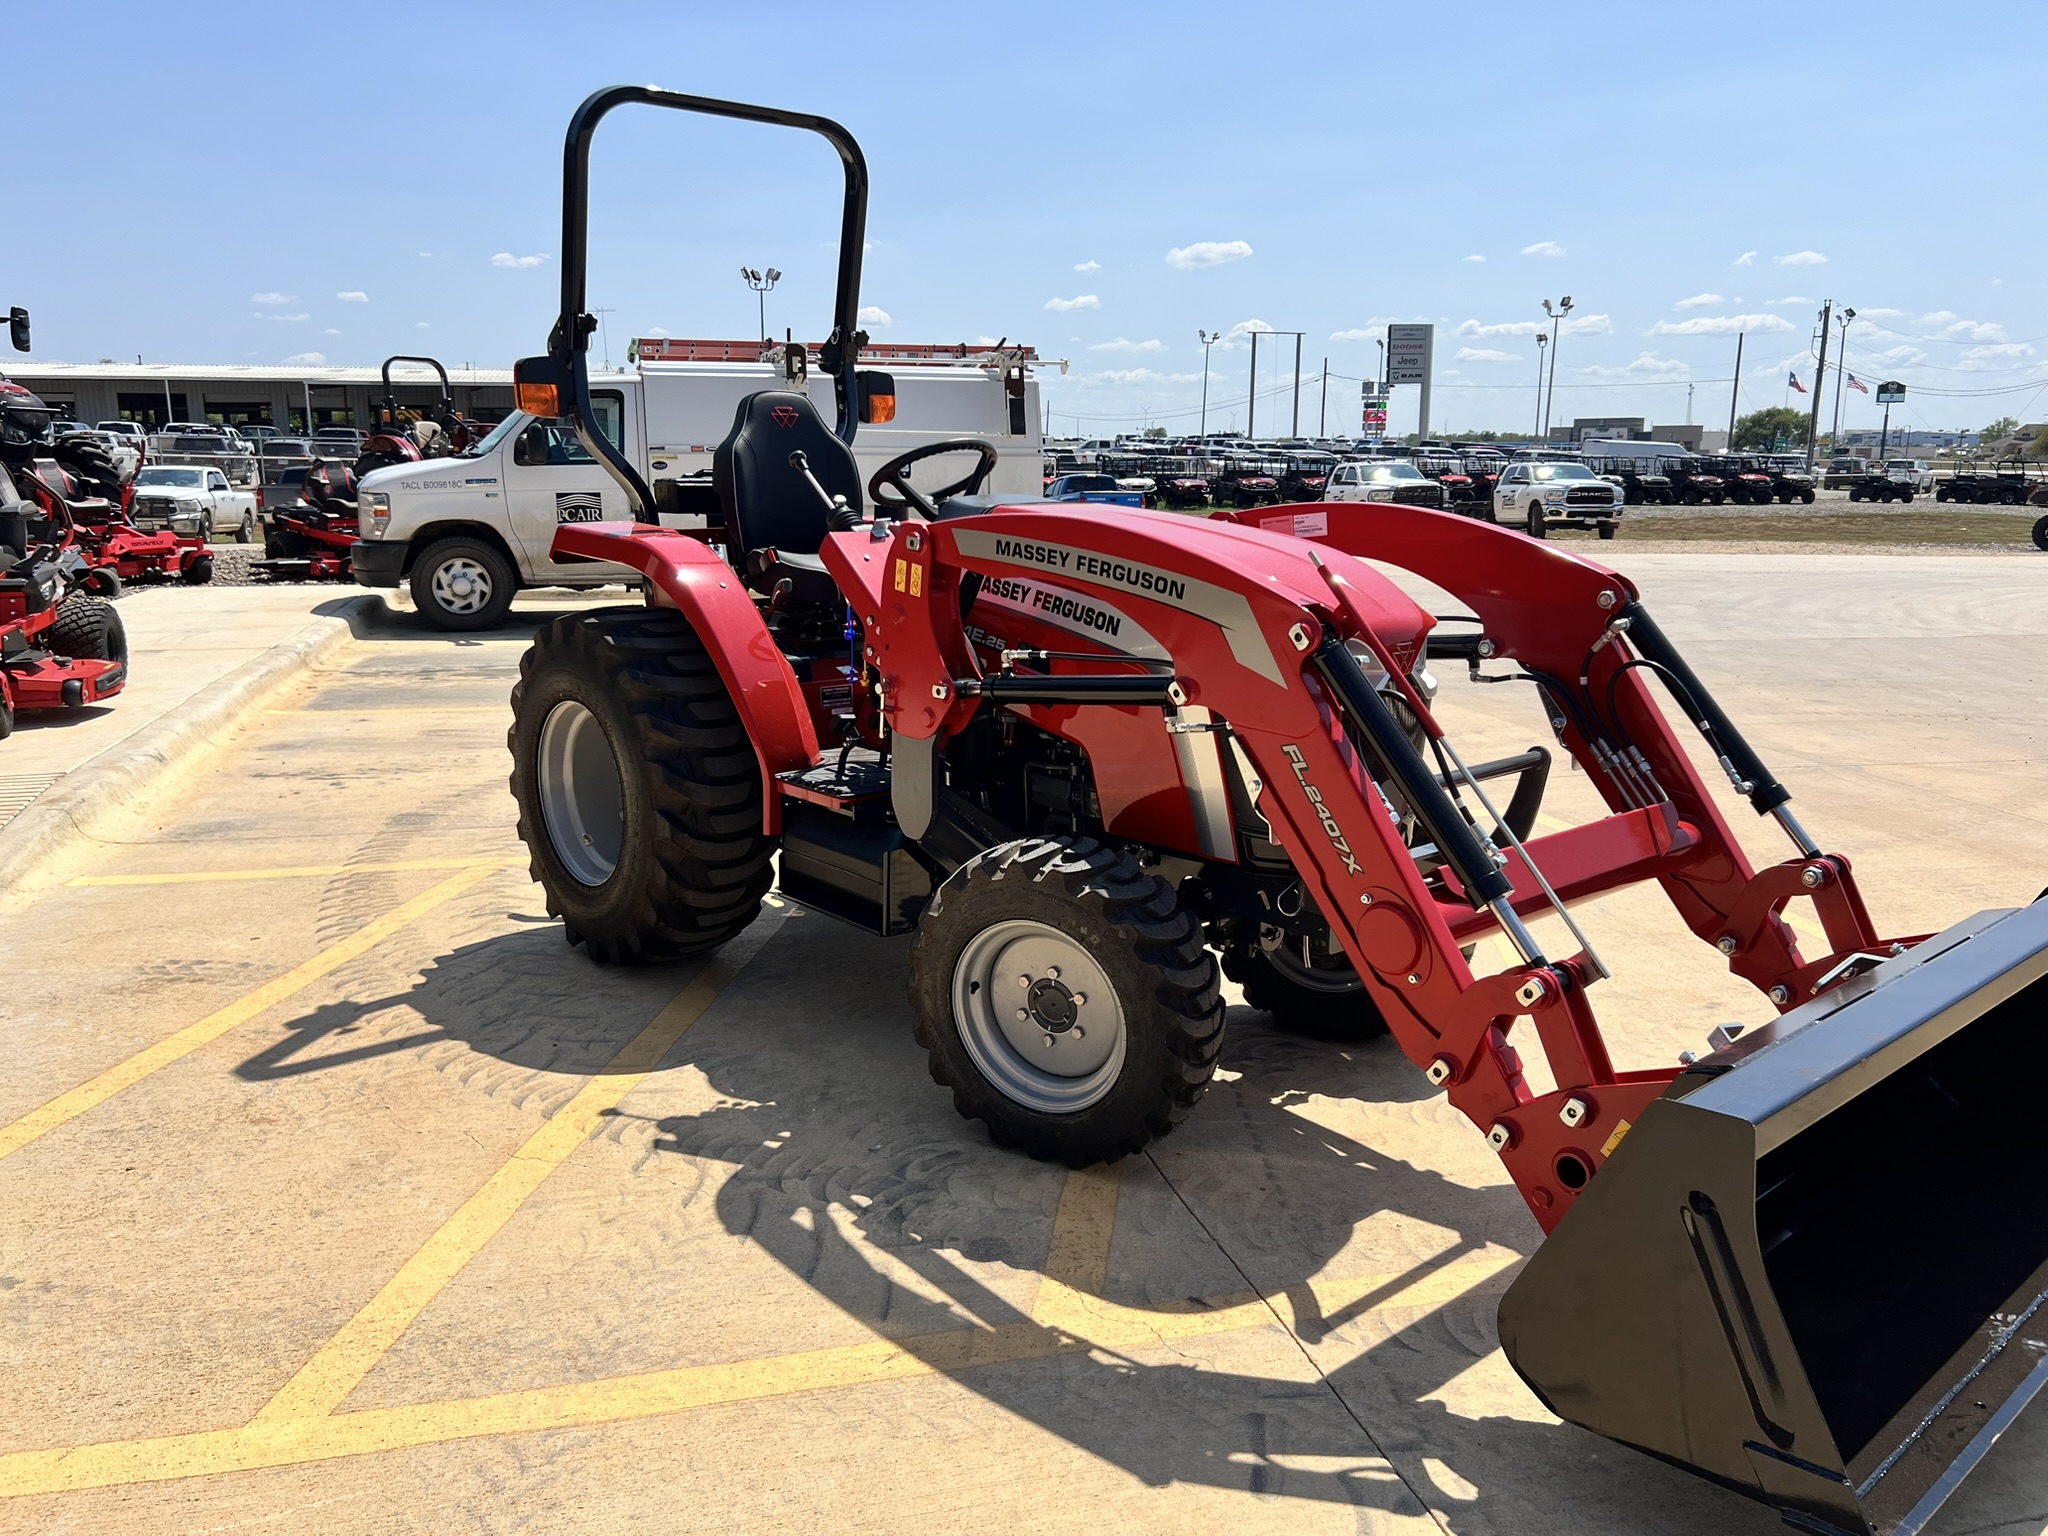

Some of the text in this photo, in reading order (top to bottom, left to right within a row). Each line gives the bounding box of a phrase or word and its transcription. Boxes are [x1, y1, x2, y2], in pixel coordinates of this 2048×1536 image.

[1397, 356, 1419, 366] Jeep
[400, 481, 422, 490] TACL
[995, 539, 1186, 600] MASSEY FERGUSON
[981, 575, 1121, 637] ASSEY FERGUSON
[1281, 743, 1366, 878] FL.2407X
